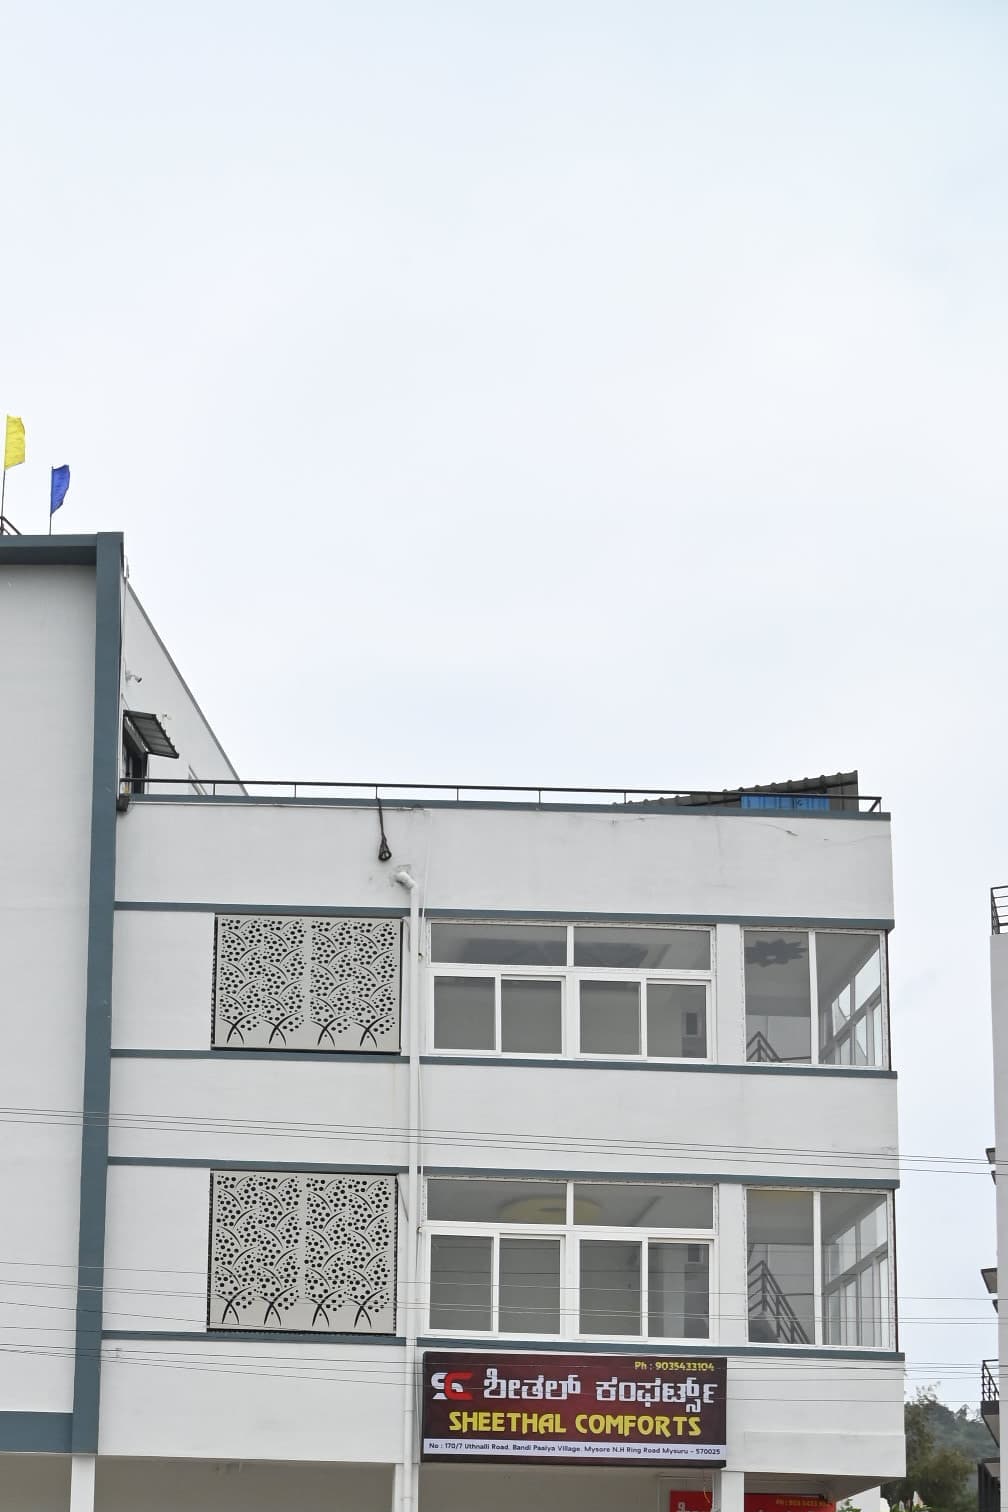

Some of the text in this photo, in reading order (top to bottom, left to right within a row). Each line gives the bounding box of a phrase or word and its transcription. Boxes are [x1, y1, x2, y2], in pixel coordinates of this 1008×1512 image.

[634, 1361, 647, 1370] Ph
[655, 1361, 715, 1371] 9035433104
[449, 1411, 701, 1438] SHEETHAL COMFORTS
